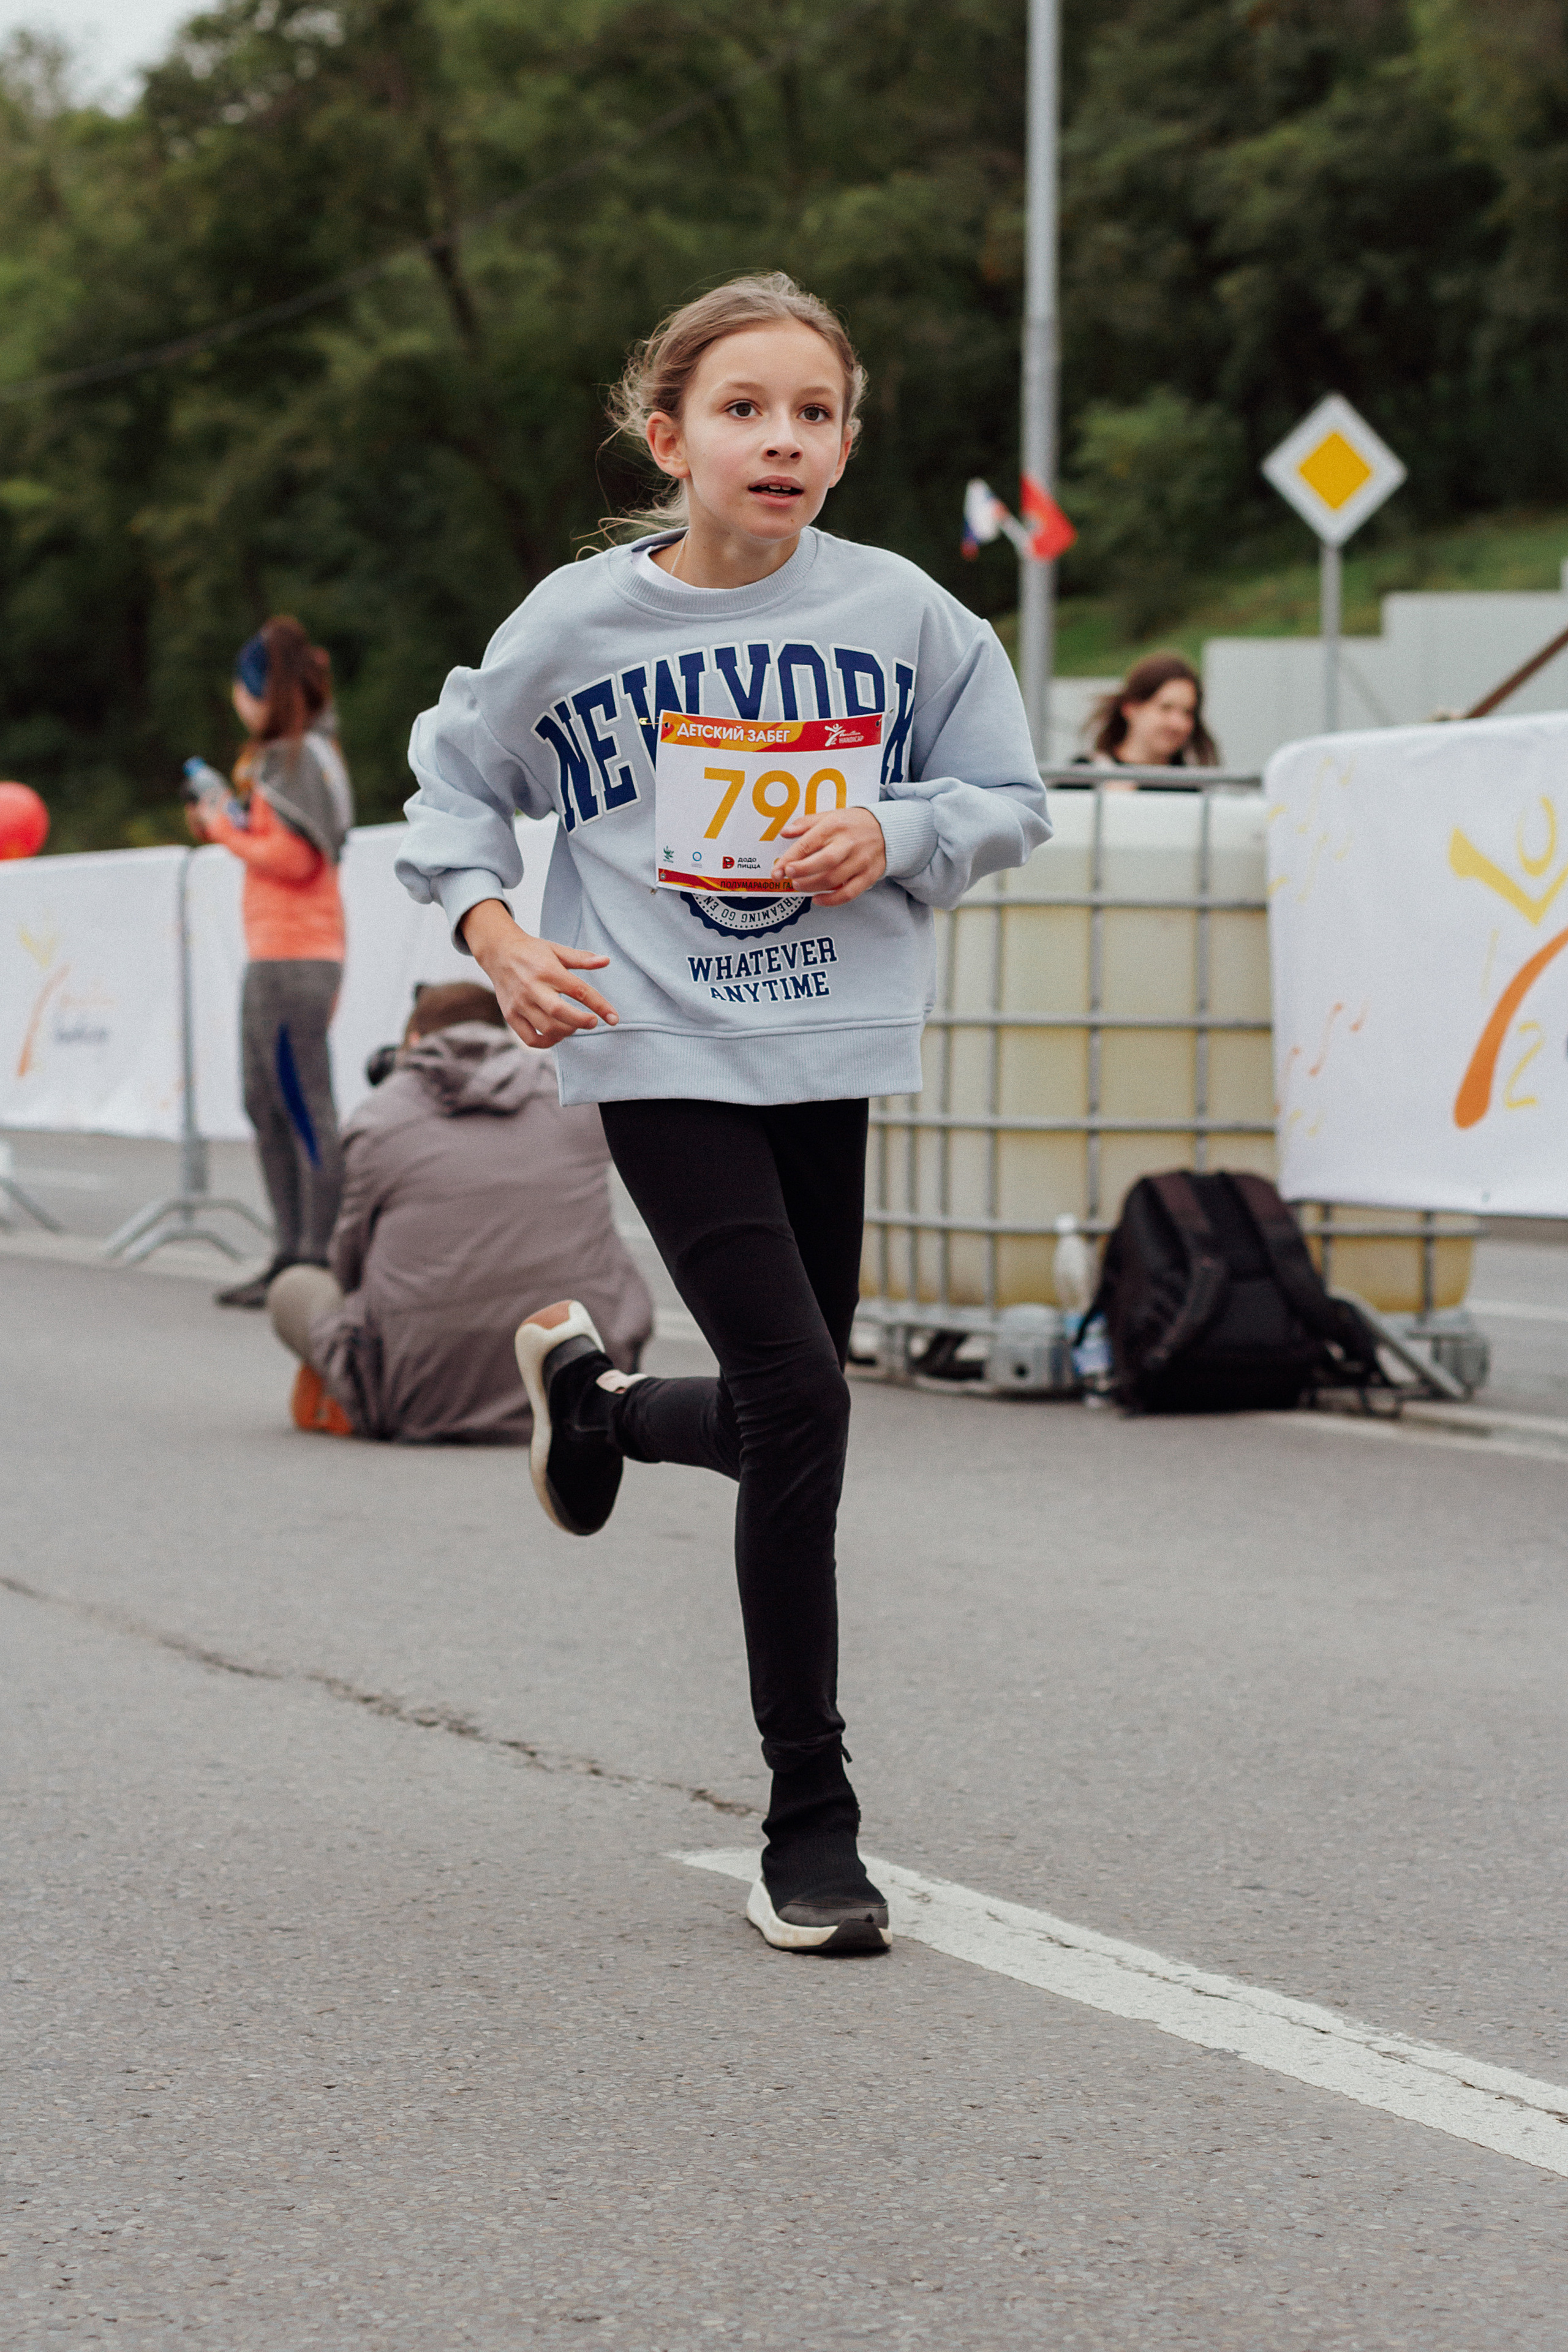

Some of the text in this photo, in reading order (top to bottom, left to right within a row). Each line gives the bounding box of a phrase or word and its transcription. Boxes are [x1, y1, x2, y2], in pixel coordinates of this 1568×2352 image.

[677, 723, 791, 742] ДЕТСКИЙ ЗАБЕГ
[703, 766, 847, 842] 790
[720, 881, 780, 889] ПОЛУМАРАФОН
[721, 908, 736, 921] GO
[687, 936, 838, 982] WHATEVER
[710, 971, 831, 1003] ANYTIME
